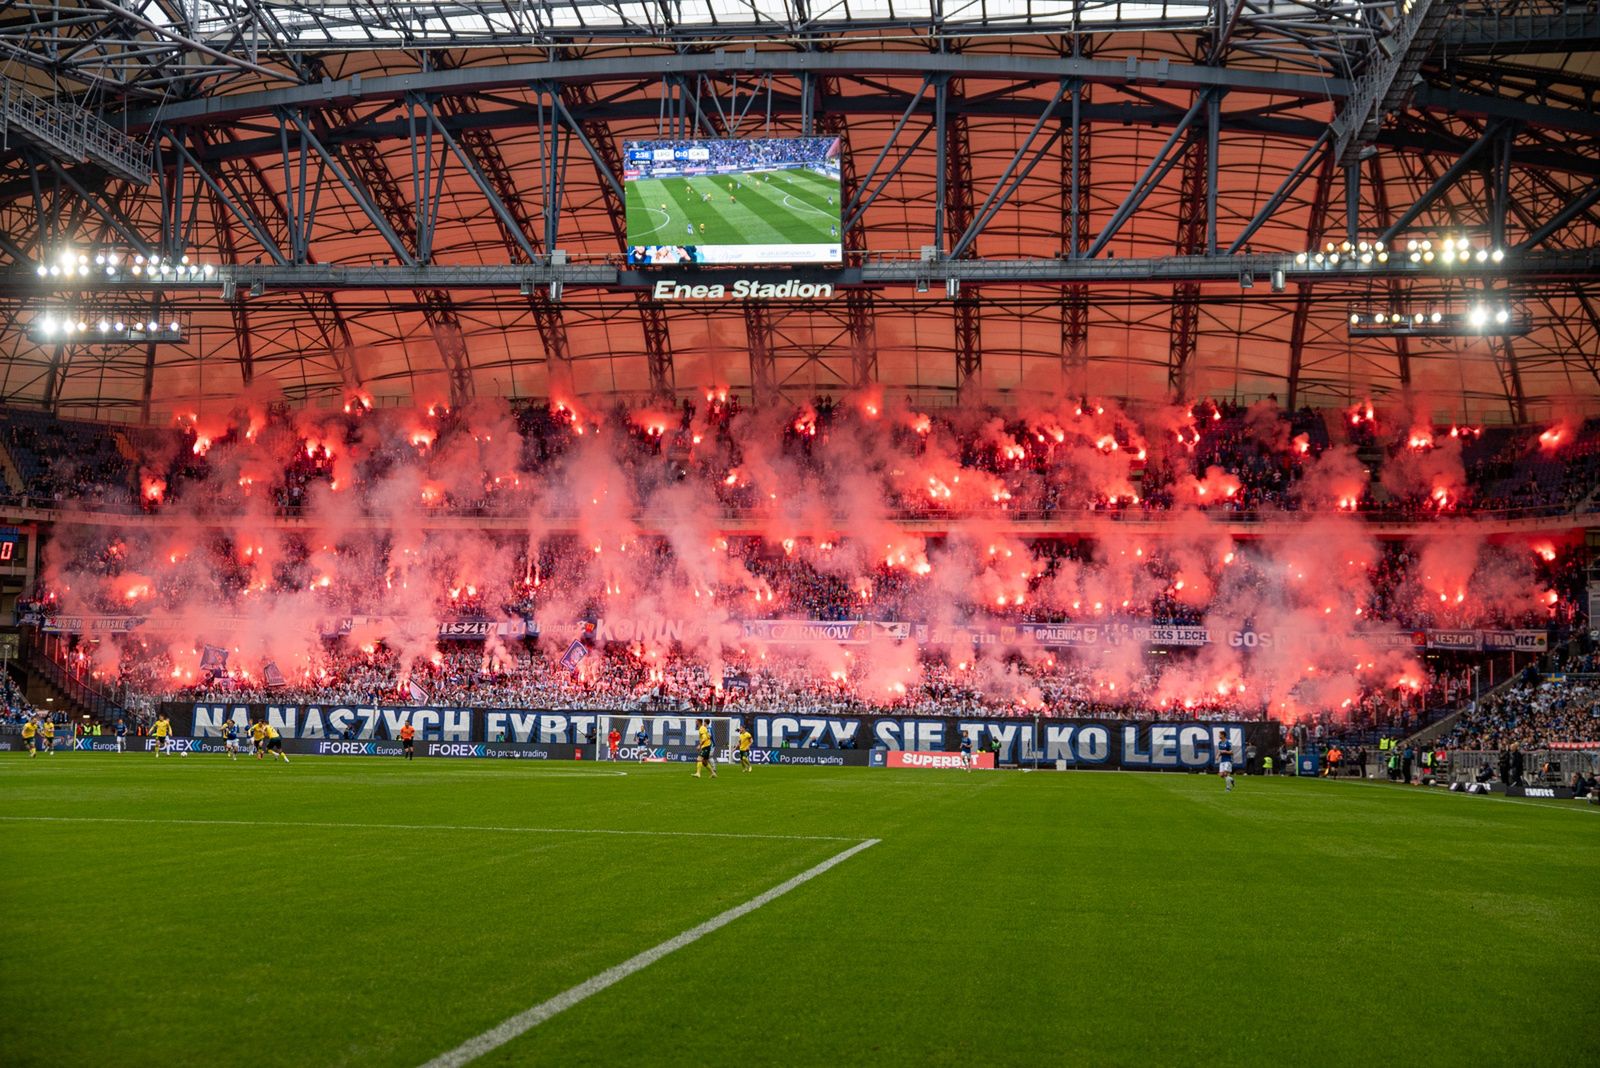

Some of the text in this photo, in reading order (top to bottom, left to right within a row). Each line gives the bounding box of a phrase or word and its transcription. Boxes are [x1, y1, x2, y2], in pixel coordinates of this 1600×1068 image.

[675, 150, 688, 158] 0:0
[654, 279, 832, 299] Enea Stadion
[1150, 630, 1208, 641] KKS LECH
[1436, 634, 1473, 645] LESZNO
[266, 706, 471, 742] NASZYCH
[960, 722, 1108, 762] TYLKO
[1124, 725, 1243, 765] LECH
[202, 744, 212, 752] Po
[319, 742, 403, 757] iFOREX Europe
[429, 744, 479, 757] iFOREX
[486, 749, 496, 758] Po
[522, 750, 548, 760] trading
[607, 747, 658, 760] iOREX
[780, 755, 790, 763] Po
[792, 756, 816, 765] prostu
[817, 755, 843, 765] trading
[902, 752, 980, 768] SUPERBT
